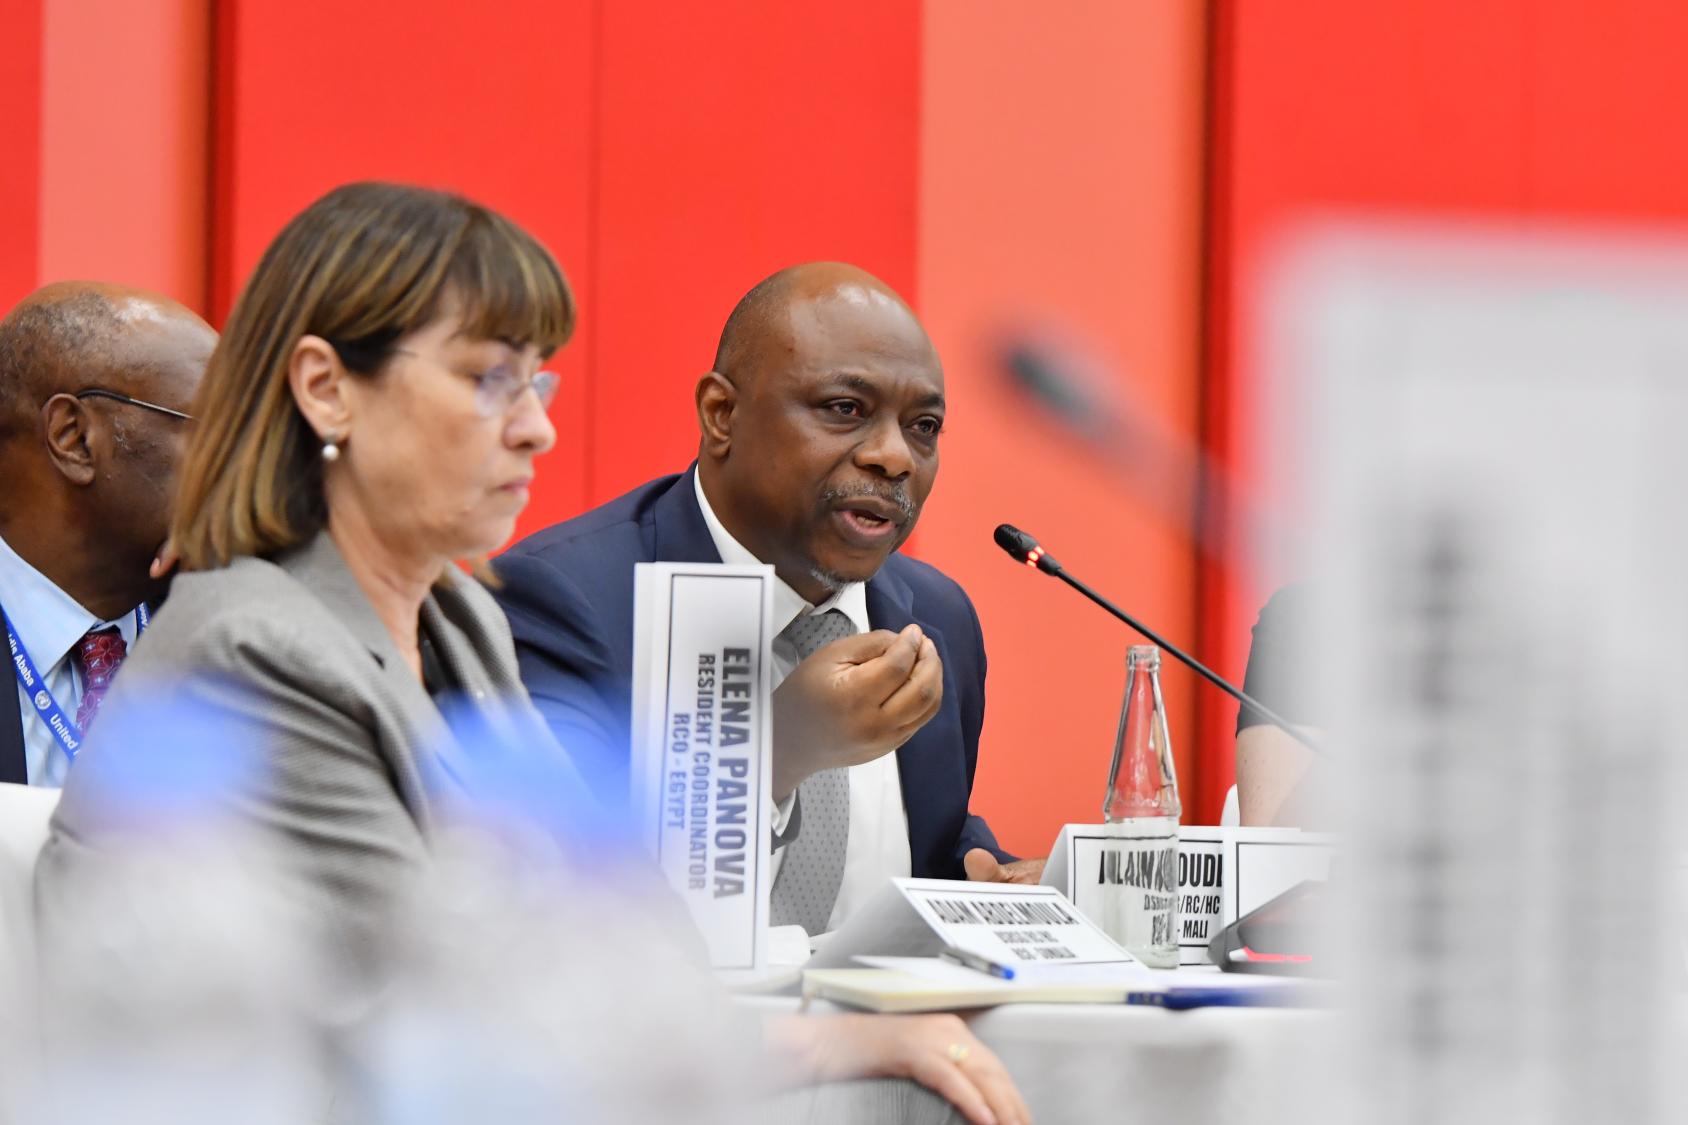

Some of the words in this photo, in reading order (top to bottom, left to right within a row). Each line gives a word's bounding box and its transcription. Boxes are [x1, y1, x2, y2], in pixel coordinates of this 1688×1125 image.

[14, 653, 34, 687] Ababa
[50, 713, 79, 750] United
[671, 712, 691, 753] RCO
[694, 653, 716, 746] RESIDENT
[719, 647, 751, 748] ELENA
[667, 771, 687, 830] EGYPT
[688, 751, 711, 891] COORDINATOR
[713, 757, 749, 900] PANOVA
[1183, 919, 1209, 939] MALI
